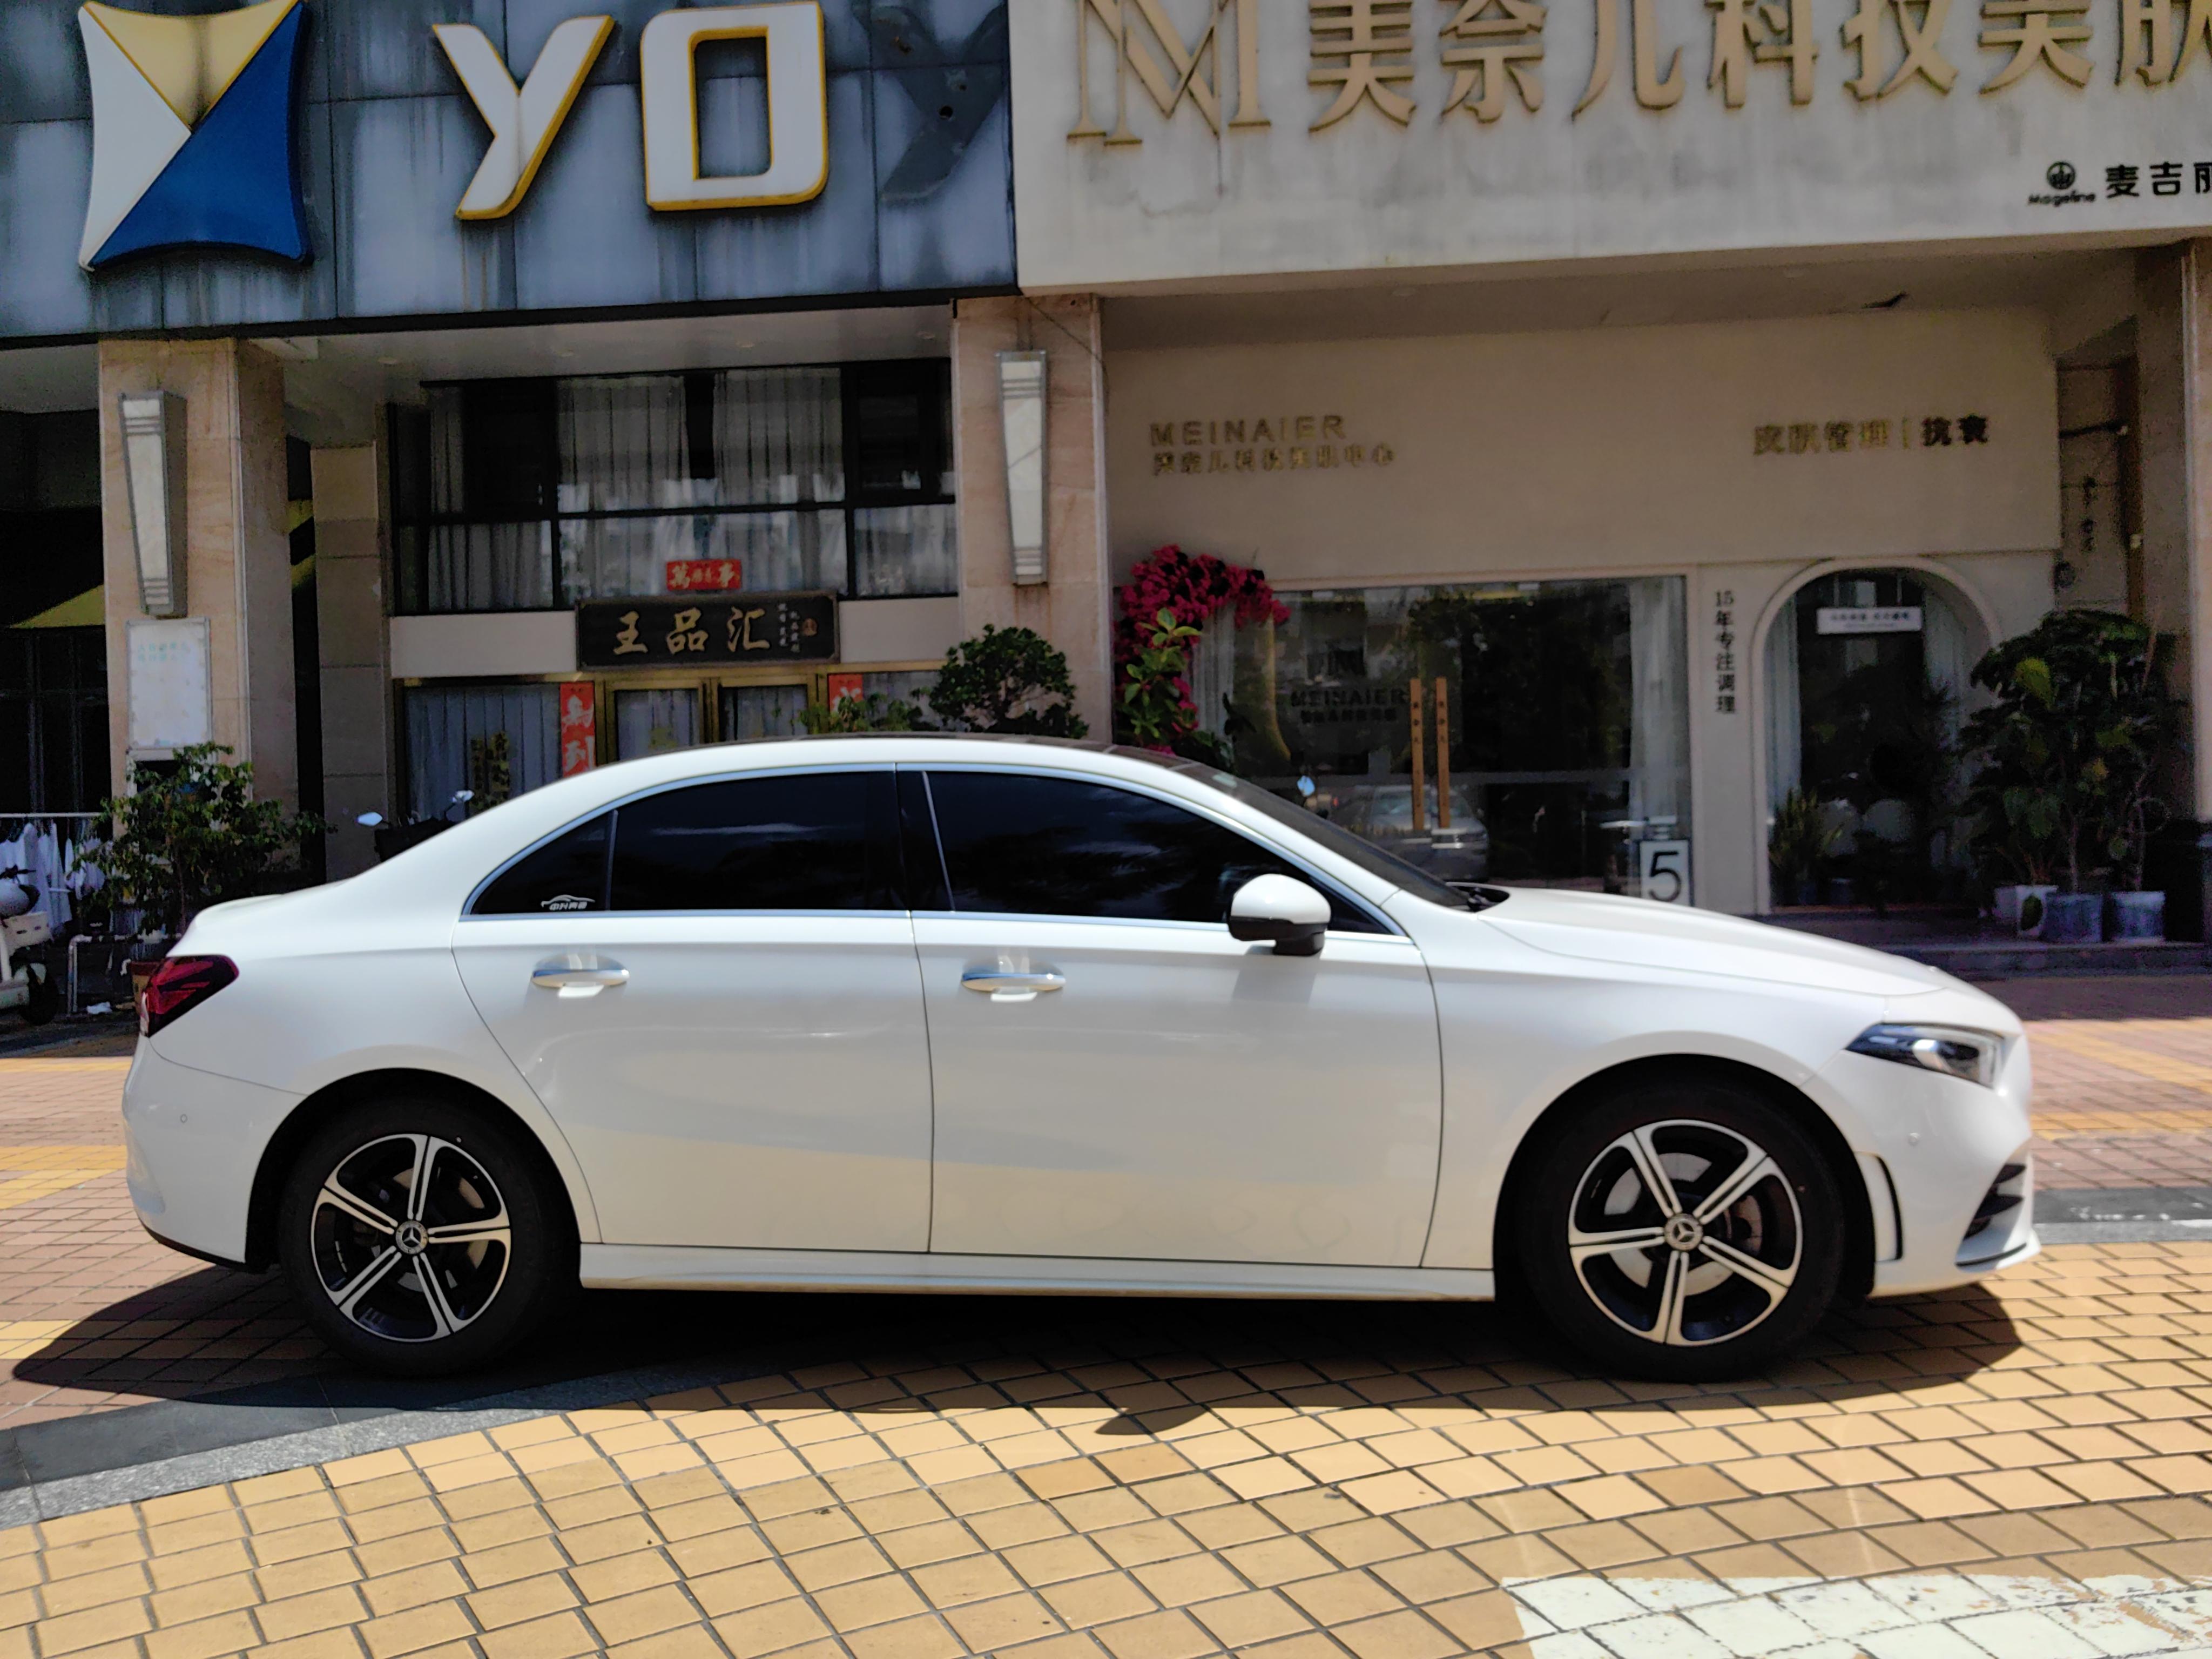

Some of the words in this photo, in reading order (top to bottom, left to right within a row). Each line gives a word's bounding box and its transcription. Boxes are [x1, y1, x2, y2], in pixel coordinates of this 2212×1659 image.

[1150, 415, 1346, 447] MEINAIER
[613, 606, 770, 655] 王品汇
